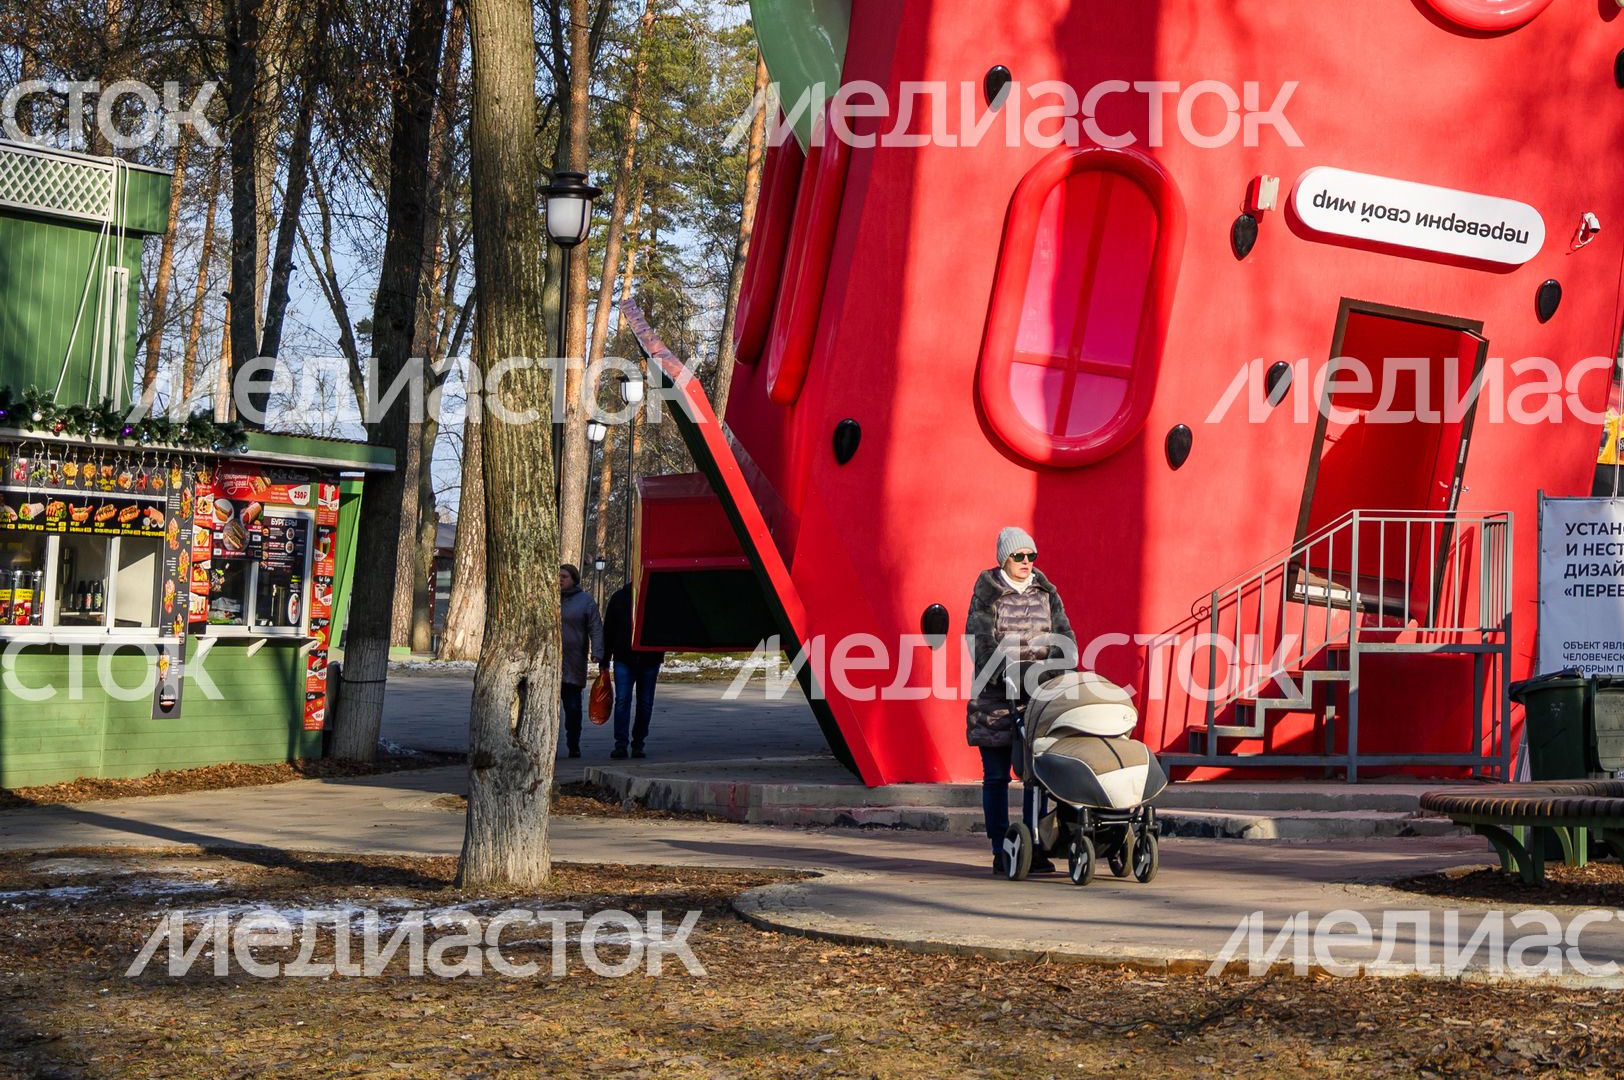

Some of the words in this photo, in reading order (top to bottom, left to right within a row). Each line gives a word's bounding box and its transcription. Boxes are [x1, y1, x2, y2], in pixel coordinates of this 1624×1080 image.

[1312, 189, 1356, 214] мир
[1361, 202, 1411, 224] свой
[1415, 211, 1529, 245] переверни
[1566, 543, 1577, 556] И
[1562, 641, 1601, 650] ОБЪЕКТ
